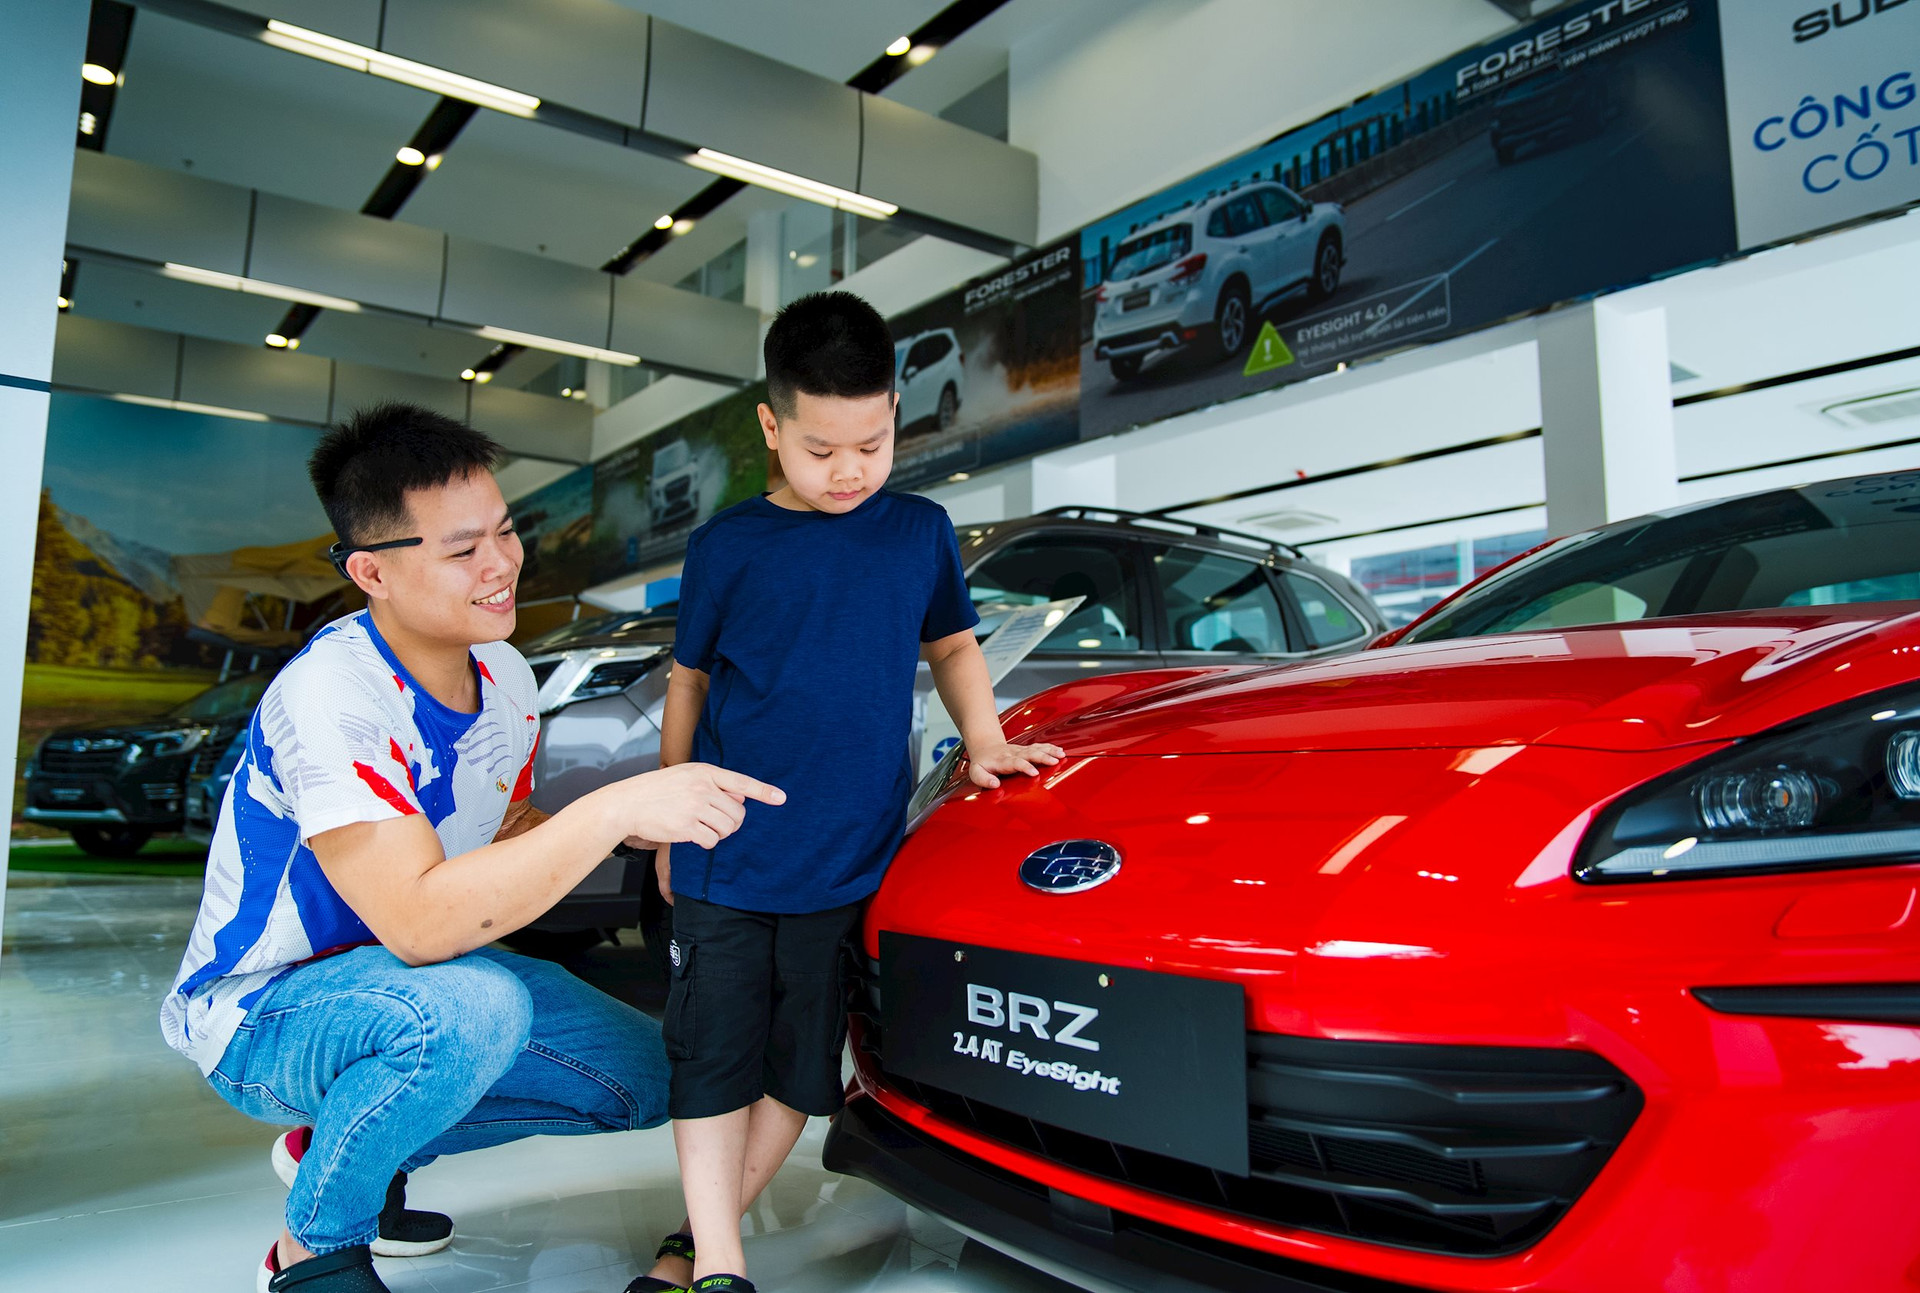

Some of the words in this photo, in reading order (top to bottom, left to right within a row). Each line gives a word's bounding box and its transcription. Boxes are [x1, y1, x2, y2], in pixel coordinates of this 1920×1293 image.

[1456, 0, 1660, 88] FORESTE
[1753, 71, 1917, 152] CÔNG
[1802, 122, 1920, 194] CỐT
[964, 246, 1071, 305] FORESTER
[1297, 310, 1361, 343] EYESIGHT
[1364, 302, 1388, 321] 4.0
[966, 983, 1100, 1051] BRZ
[953, 1031, 979, 1058] 2.4
[980, 1038, 1003, 1064] AT
[1006, 1049, 1122, 1095] EyeSight
